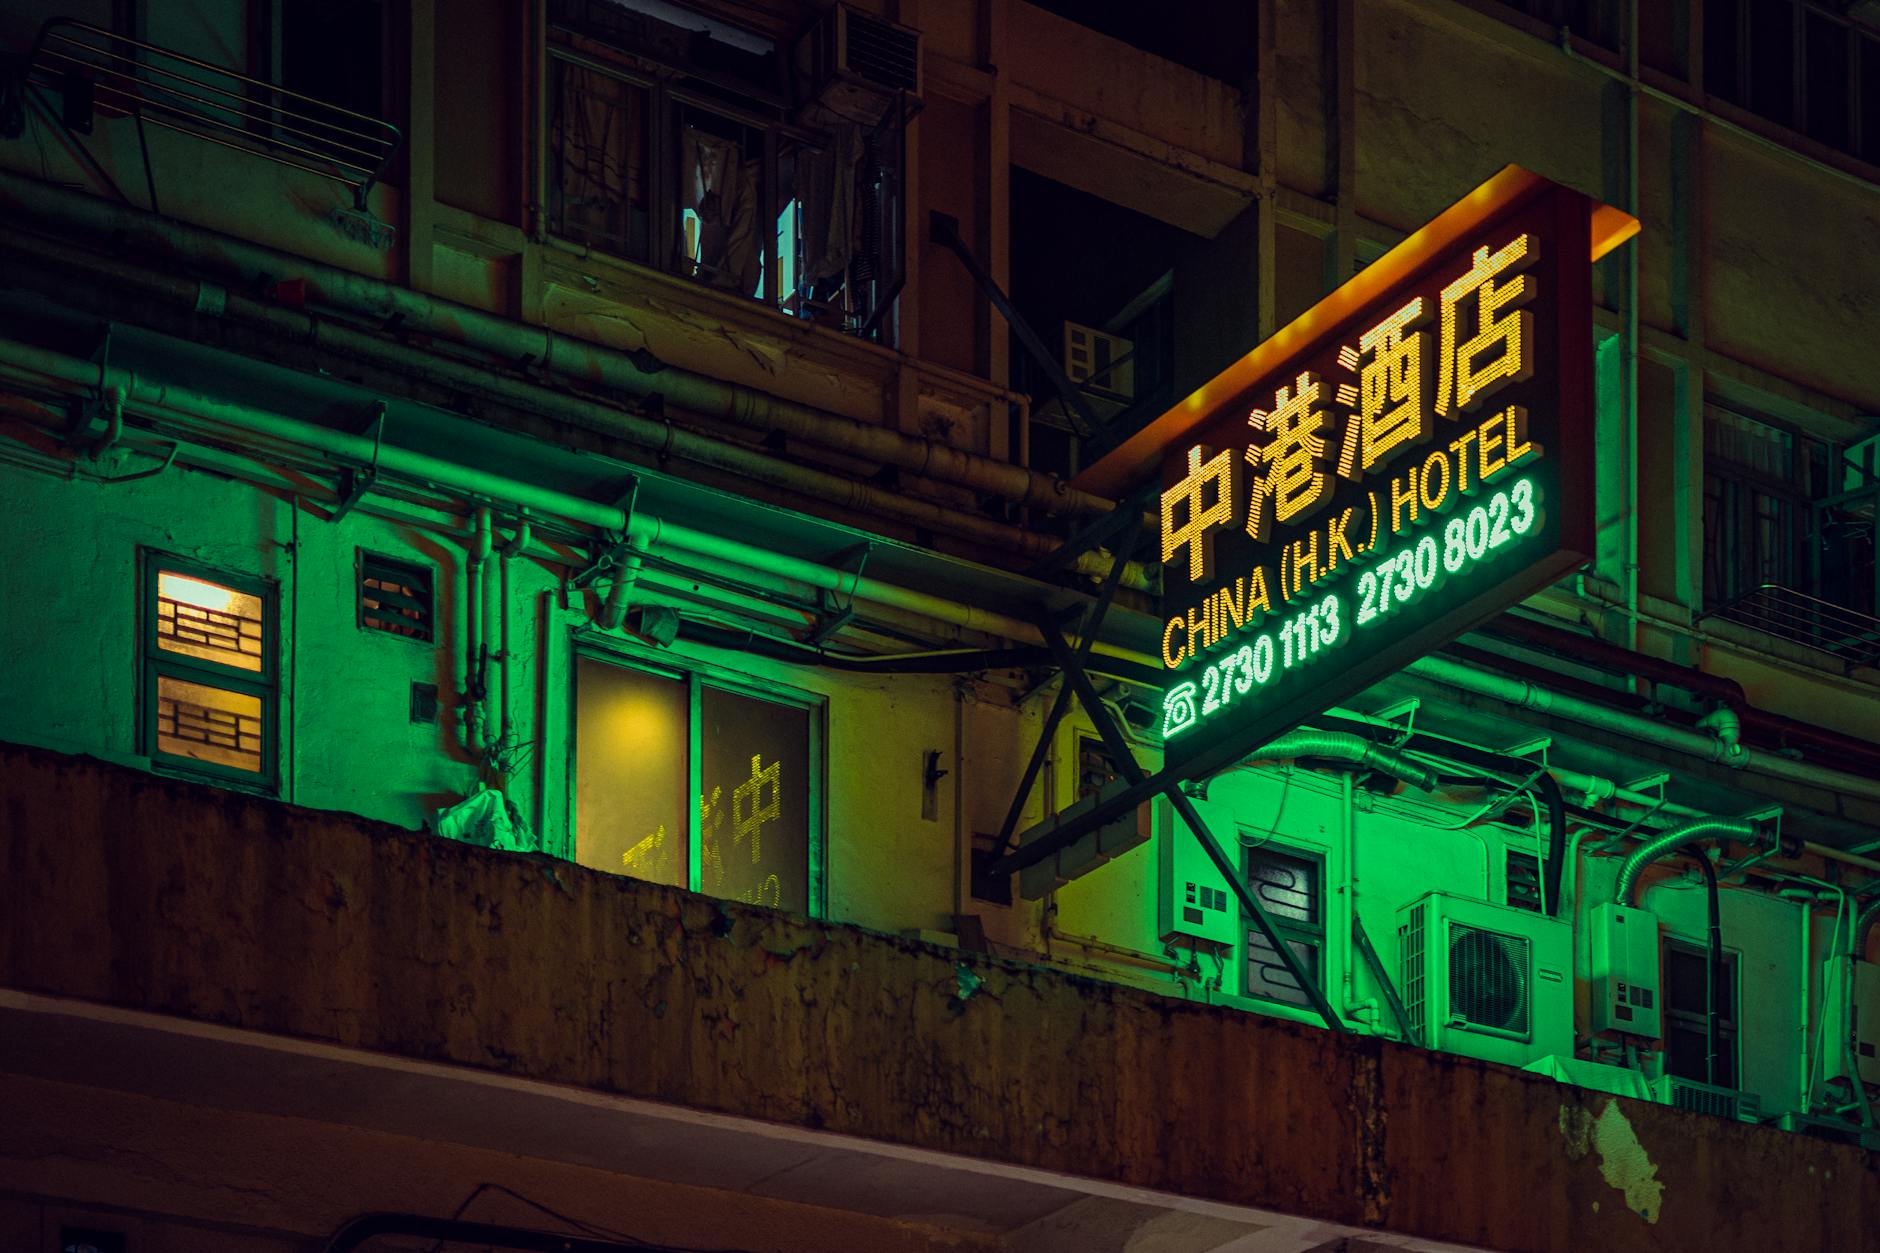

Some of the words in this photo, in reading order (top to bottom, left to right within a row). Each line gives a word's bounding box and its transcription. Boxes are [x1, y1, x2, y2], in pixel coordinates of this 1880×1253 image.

[1161, 233, 1529, 582] 中港酒店
[1162, 566, 1271, 669] CHINA
[1281, 492, 1378, 601] (H.K.)
[1391, 405, 1532, 533] HOTEL
[1201, 634, 1274, 716] 2730
[1279, 594, 1340, 668] 1113
[1357, 535, 1438, 626] 2730
[1443, 478, 1535, 573] 8023
